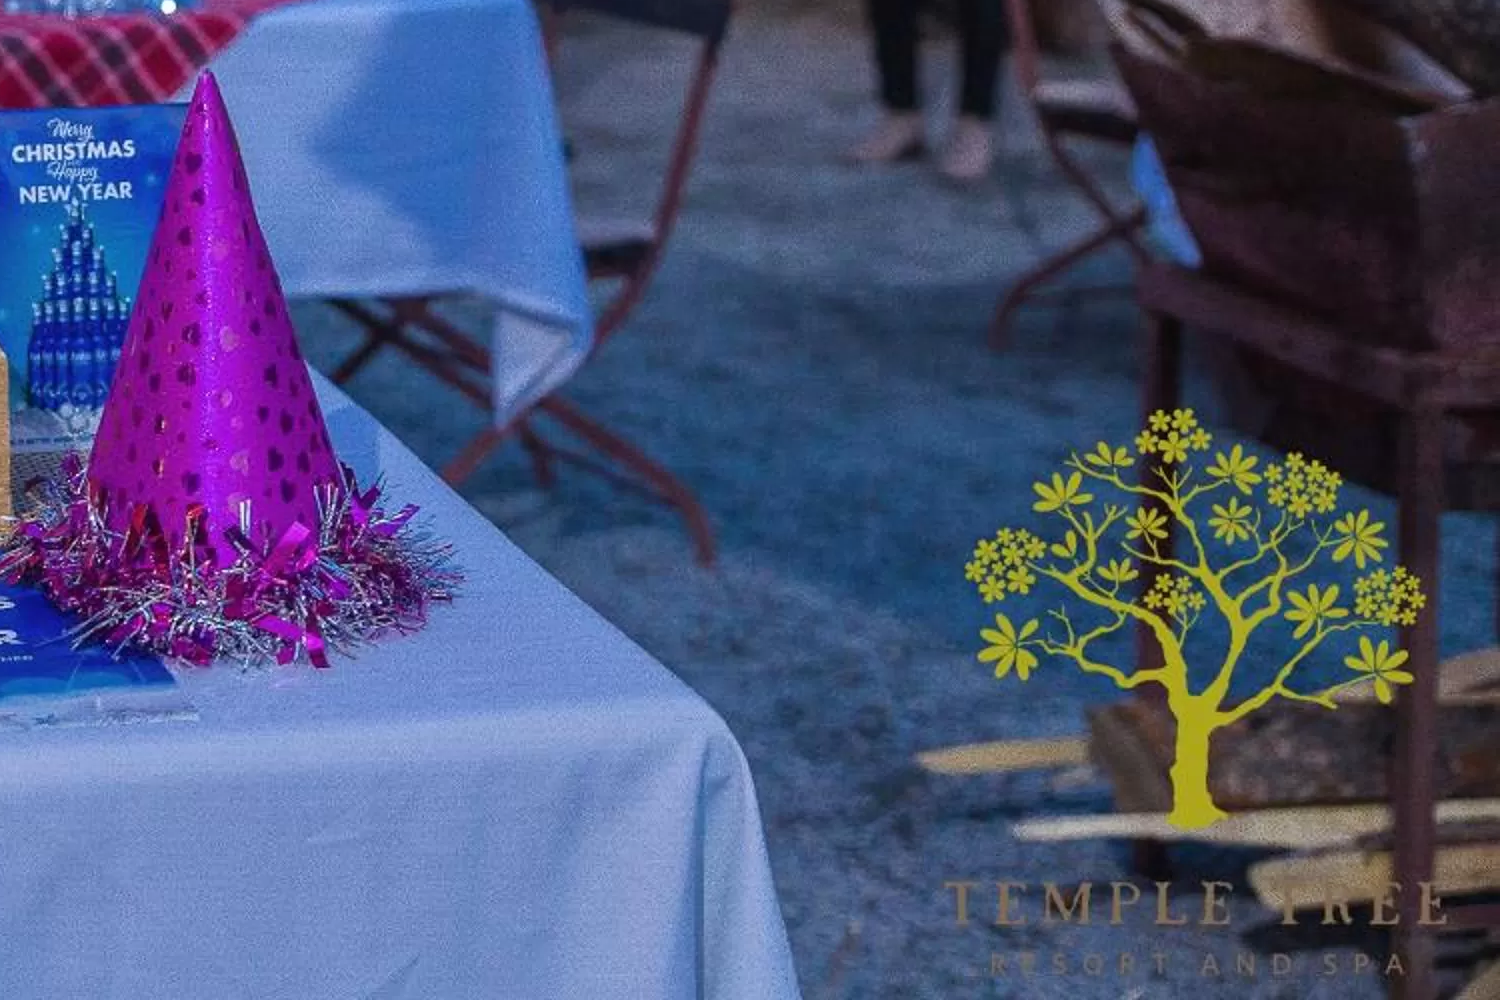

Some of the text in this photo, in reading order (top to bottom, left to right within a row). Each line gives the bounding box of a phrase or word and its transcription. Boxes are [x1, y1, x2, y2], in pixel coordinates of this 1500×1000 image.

[47, 117, 95, 143] Merry
[11, 139, 136, 163] CHRISTMAS
[46, 160, 99, 184] Happy
[19, 181, 133, 205] NEW YEAR
